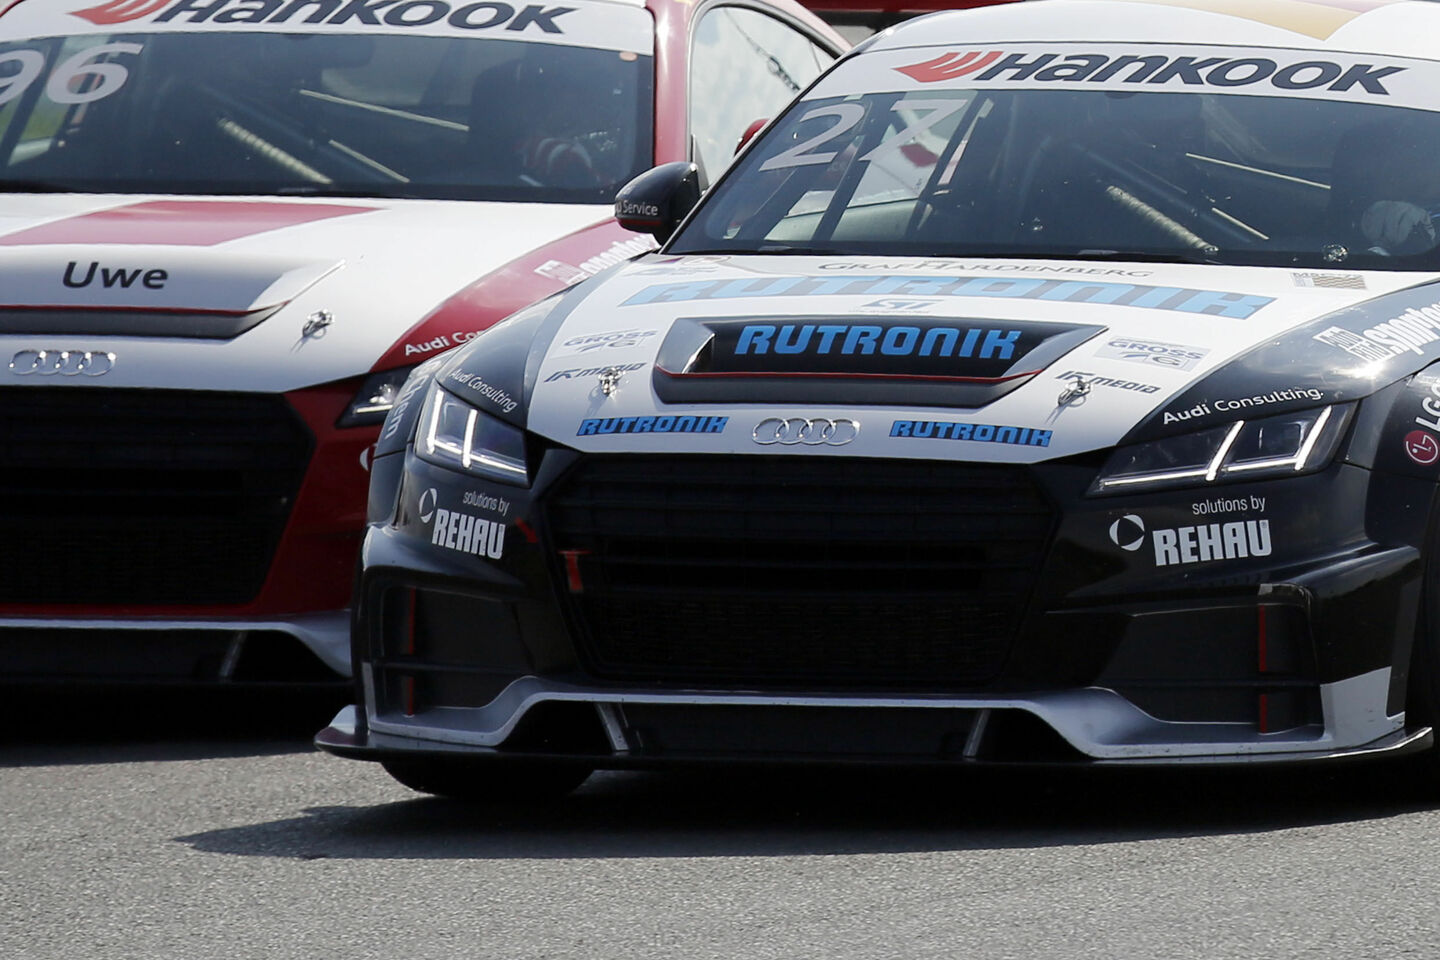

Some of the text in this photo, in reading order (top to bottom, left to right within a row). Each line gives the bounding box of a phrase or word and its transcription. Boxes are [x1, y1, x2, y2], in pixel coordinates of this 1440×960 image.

[758, 98, 967, 172] 27
[623, 201, 658, 216] Service
[62, 261, 169, 290] Uwe
[405, 334, 450, 356] Audi
[735, 325, 1022, 359] RUTRONIK
[450, 368, 469, 383] Audi
[467, 376, 518, 413] Consulting
[578, 417, 727, 436] RUTRONIK
[1163, 403, 1211, 425] Audi
[891, 421, 1053, 446] RUTRONIK
[463, 490, 510, 516] solutions by
[1192, 496, 1266, 515] solutions by
[432, 508, 506, 560] REHAU
[1152, 520, 1272, 567] REHAU
